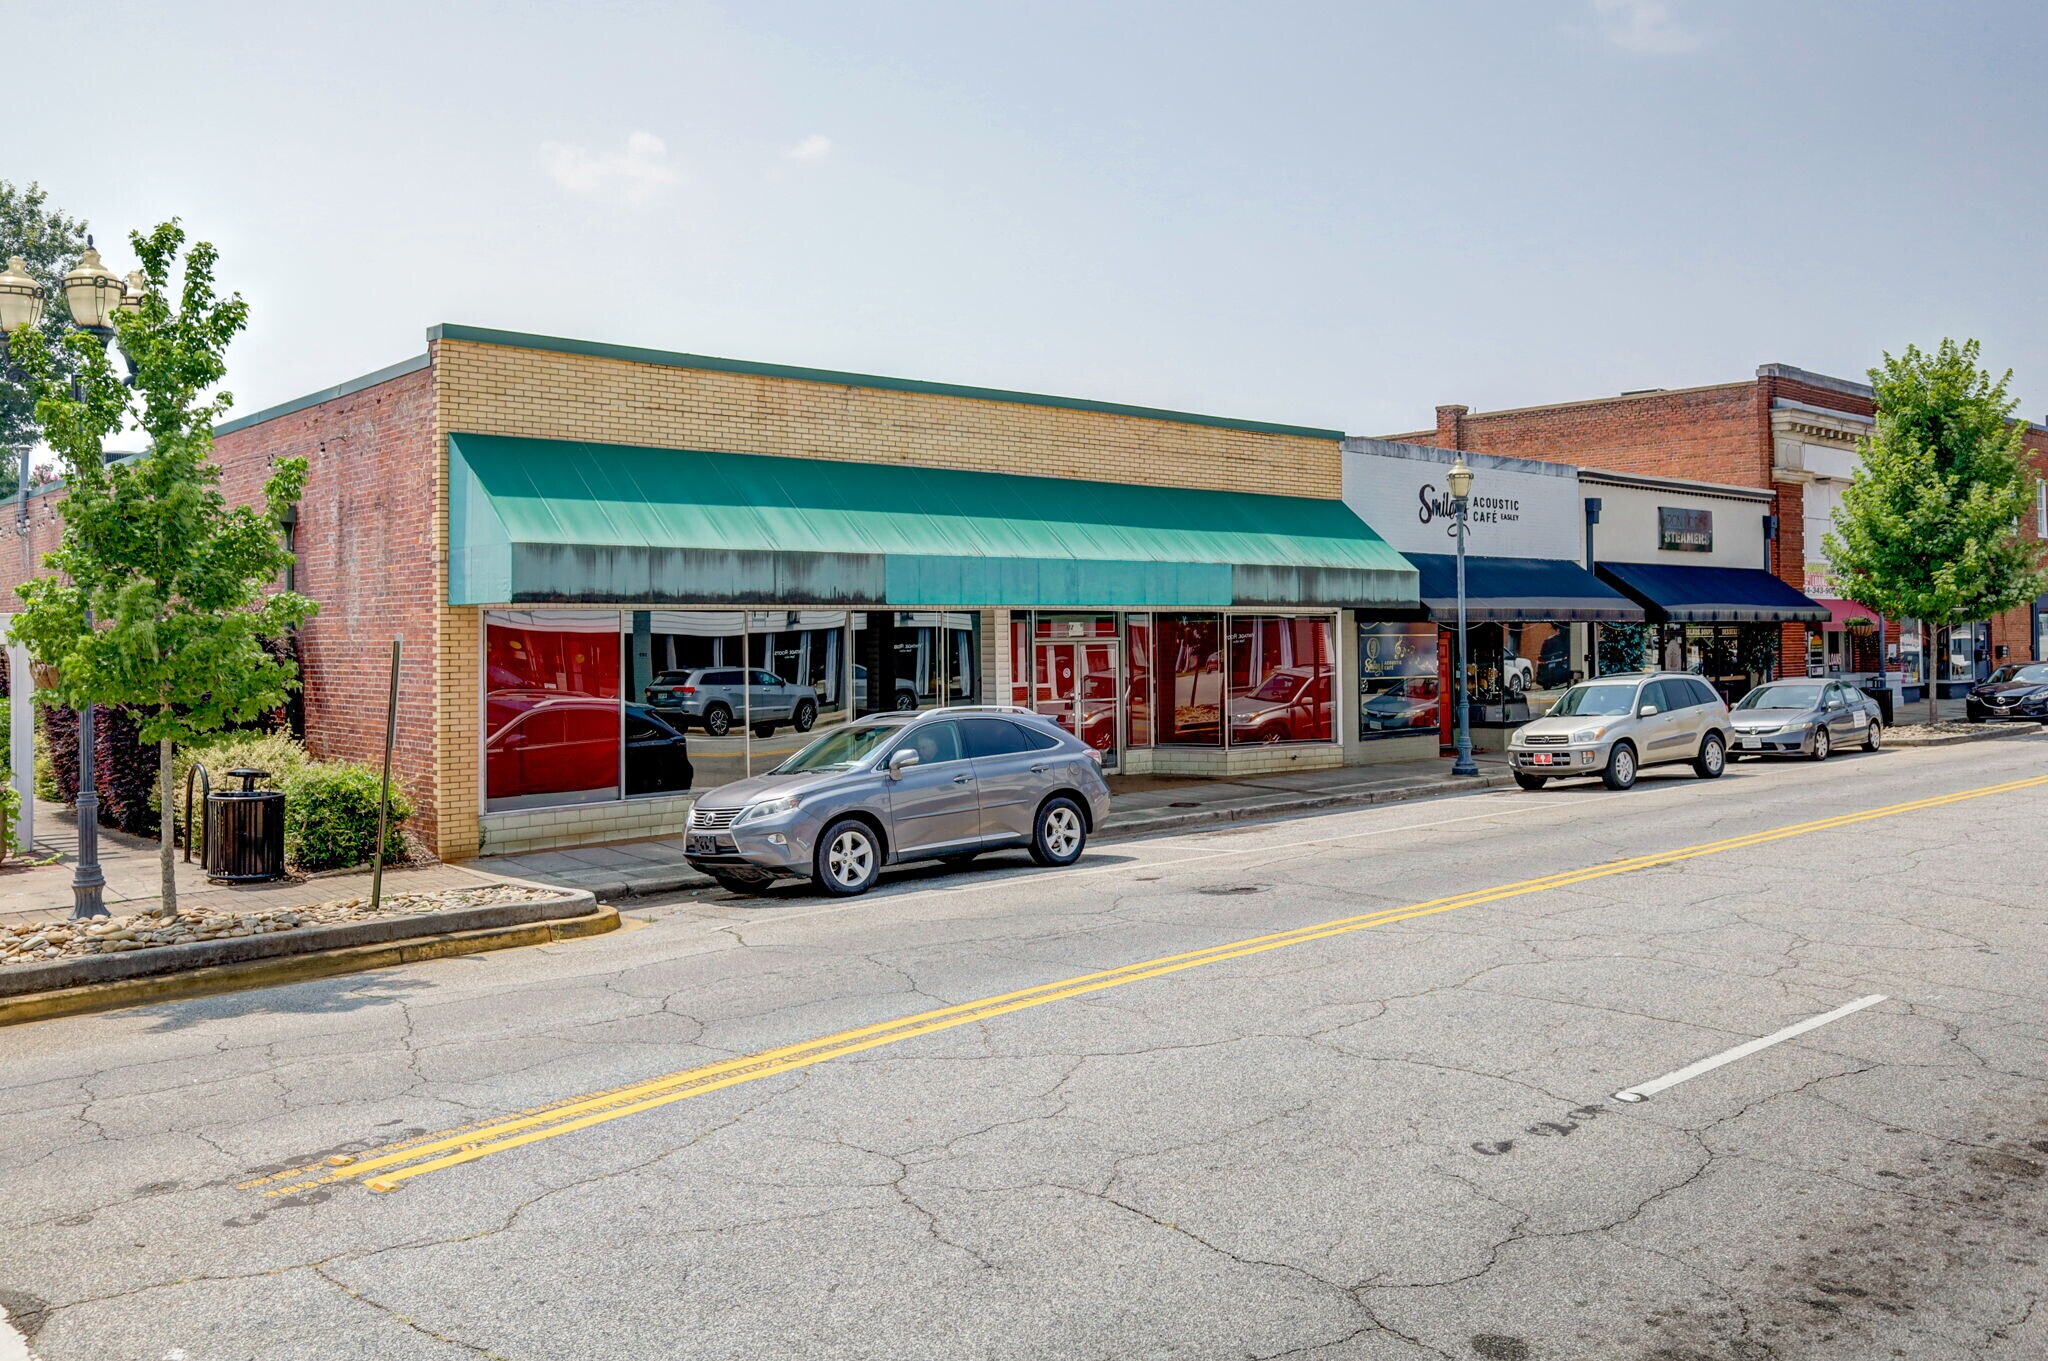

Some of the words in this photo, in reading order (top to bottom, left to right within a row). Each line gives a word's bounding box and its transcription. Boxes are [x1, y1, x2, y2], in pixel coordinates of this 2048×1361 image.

[1473, 497, 1519, 511] ACOUSTIC
[1473, 510, 1498, 523] CAFÉ
[1501, 513, 1519, 521] EASLEY
[1664, 531, 1710, 545] STEAMERS
